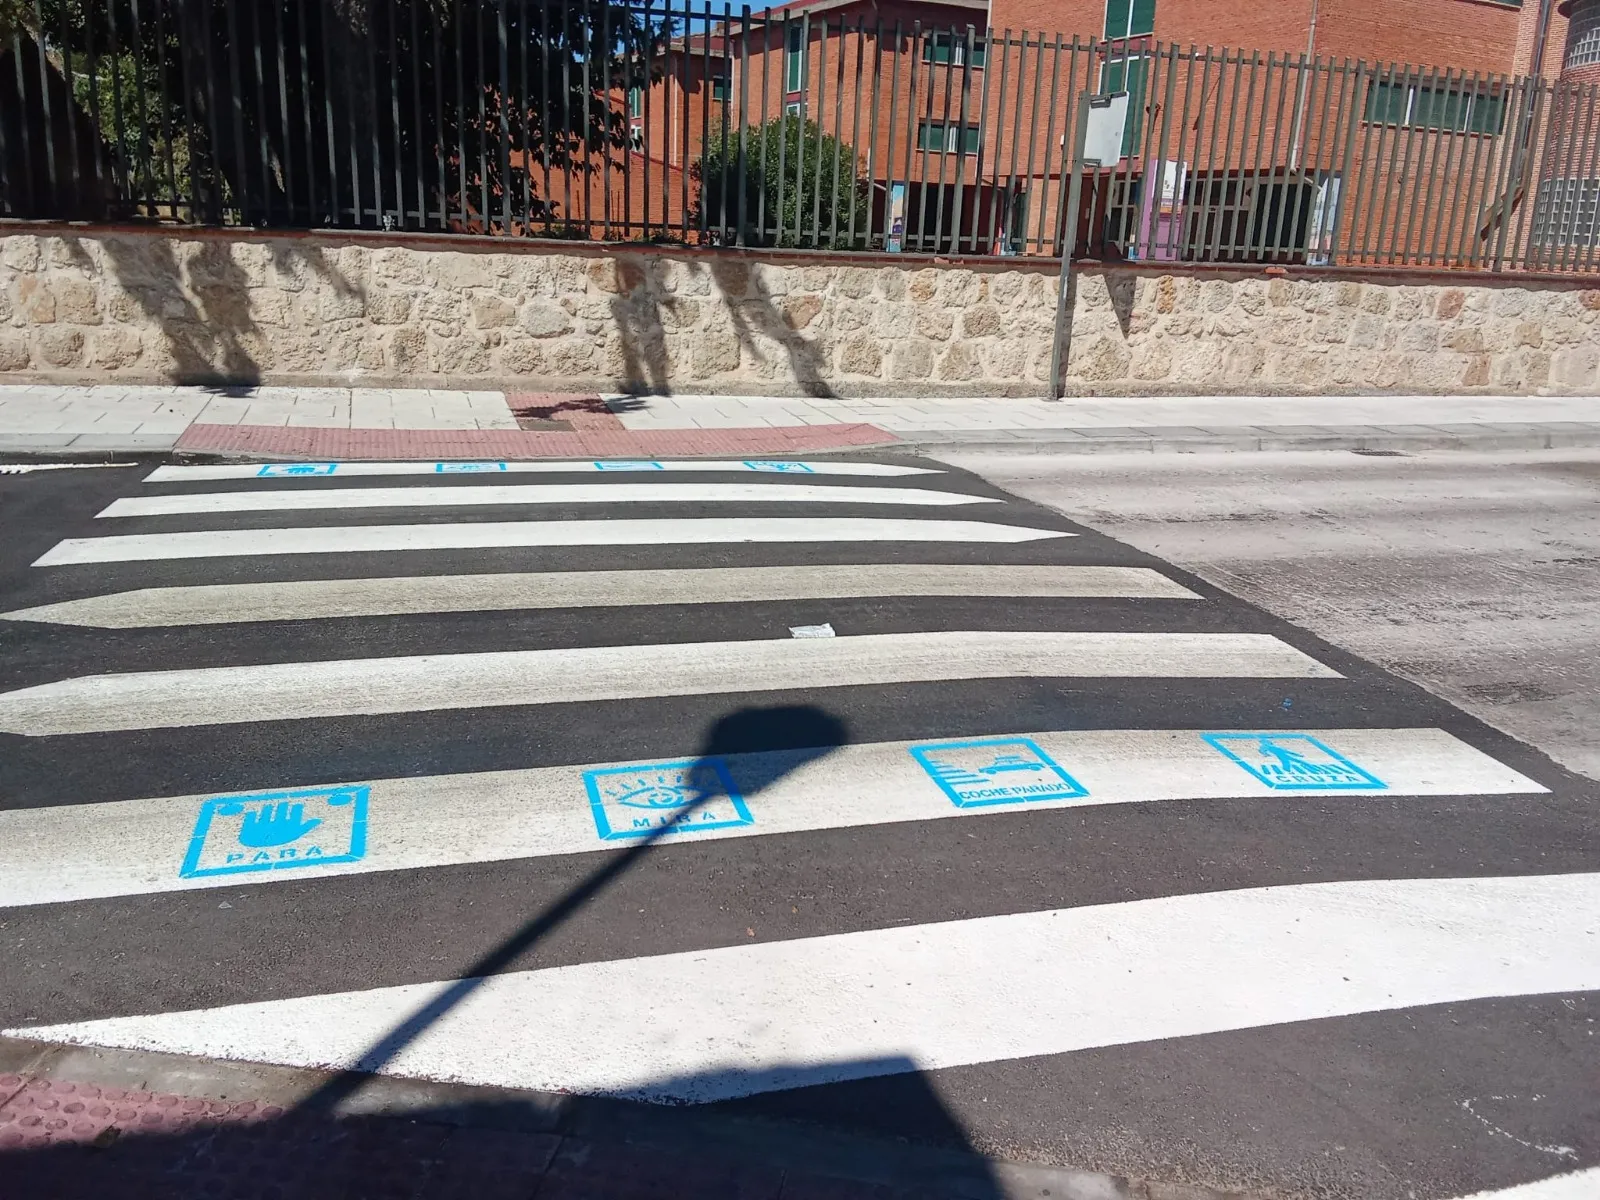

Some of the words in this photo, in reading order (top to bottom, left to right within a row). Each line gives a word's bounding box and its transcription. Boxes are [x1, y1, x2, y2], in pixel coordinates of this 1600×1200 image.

[1275, 774, 1359, 783] CRUZA
[959, 787, 1010, 800] COCHE
[1010, 783, 1072, 796] PARADO
[632, 811, 716, 827] MIRA
[226, 845, 323, 863] PARA
